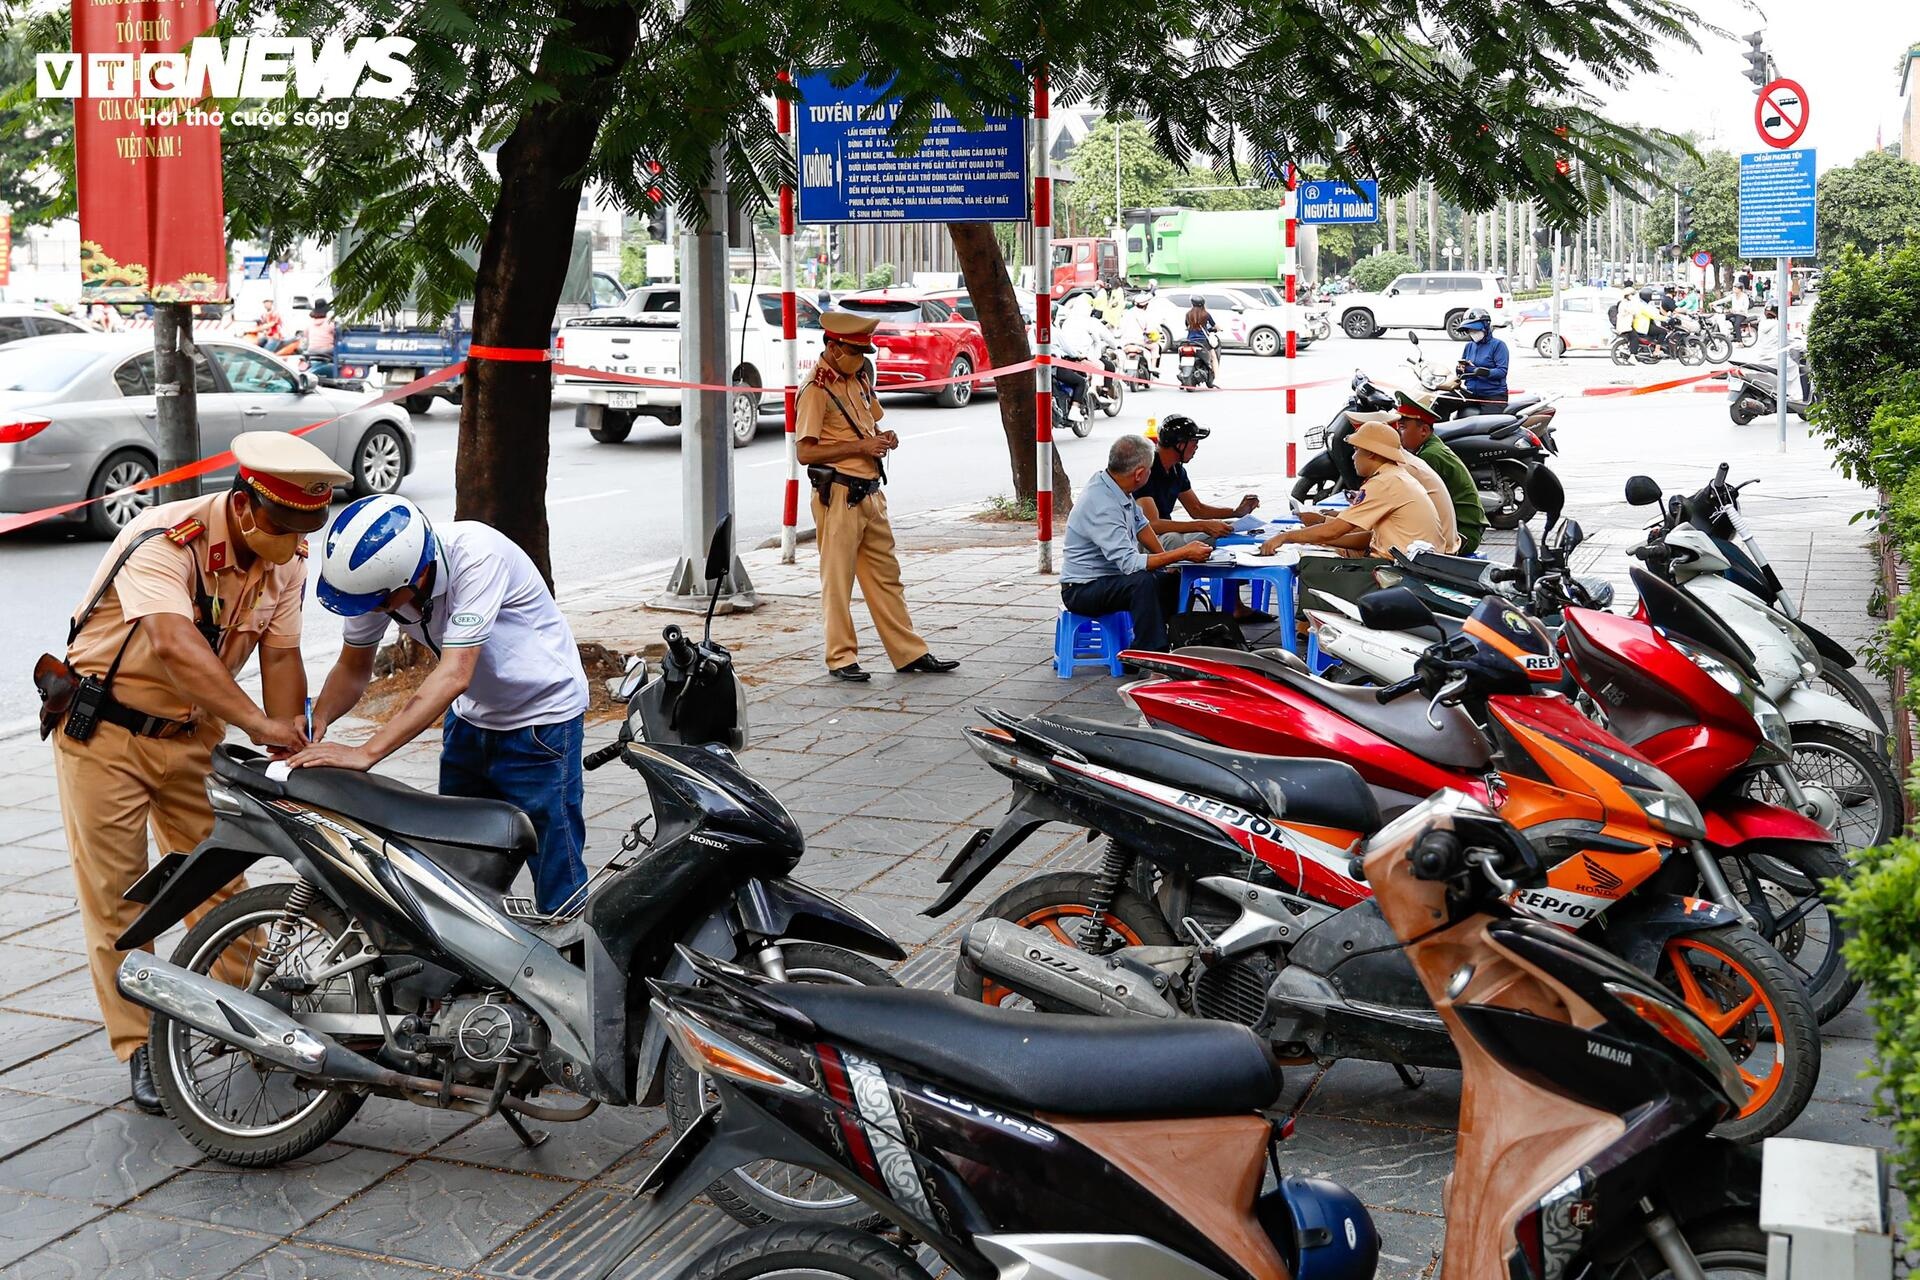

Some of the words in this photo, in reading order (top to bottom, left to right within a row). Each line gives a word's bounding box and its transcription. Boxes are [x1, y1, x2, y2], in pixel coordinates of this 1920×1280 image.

[116, 10, 134, 43] TỔ
[135, 13, 171, 42] CHỨC
[809, 101, 852, 122] TUYẾN
[115, 131, 142, 165] VIỆT
[144, 136, 174, 158] NAM
[803, 147, 833, 188] KHÔNG
[1304, 199, 1340, 218] NGUYỄN
[1343, 201, 1373, 217] HOÀNG
[567, 365, 676, 374] ANGER
[1176, 792, 1283, 843] REPSOL
[1517, 889, 1597, 920] REPSOL
[1576, 884, 1620, 898] HONDA
[738, 1034, 794, 1069] Automatic
[1587, 1040, 1632, 1066] YAMAHA
